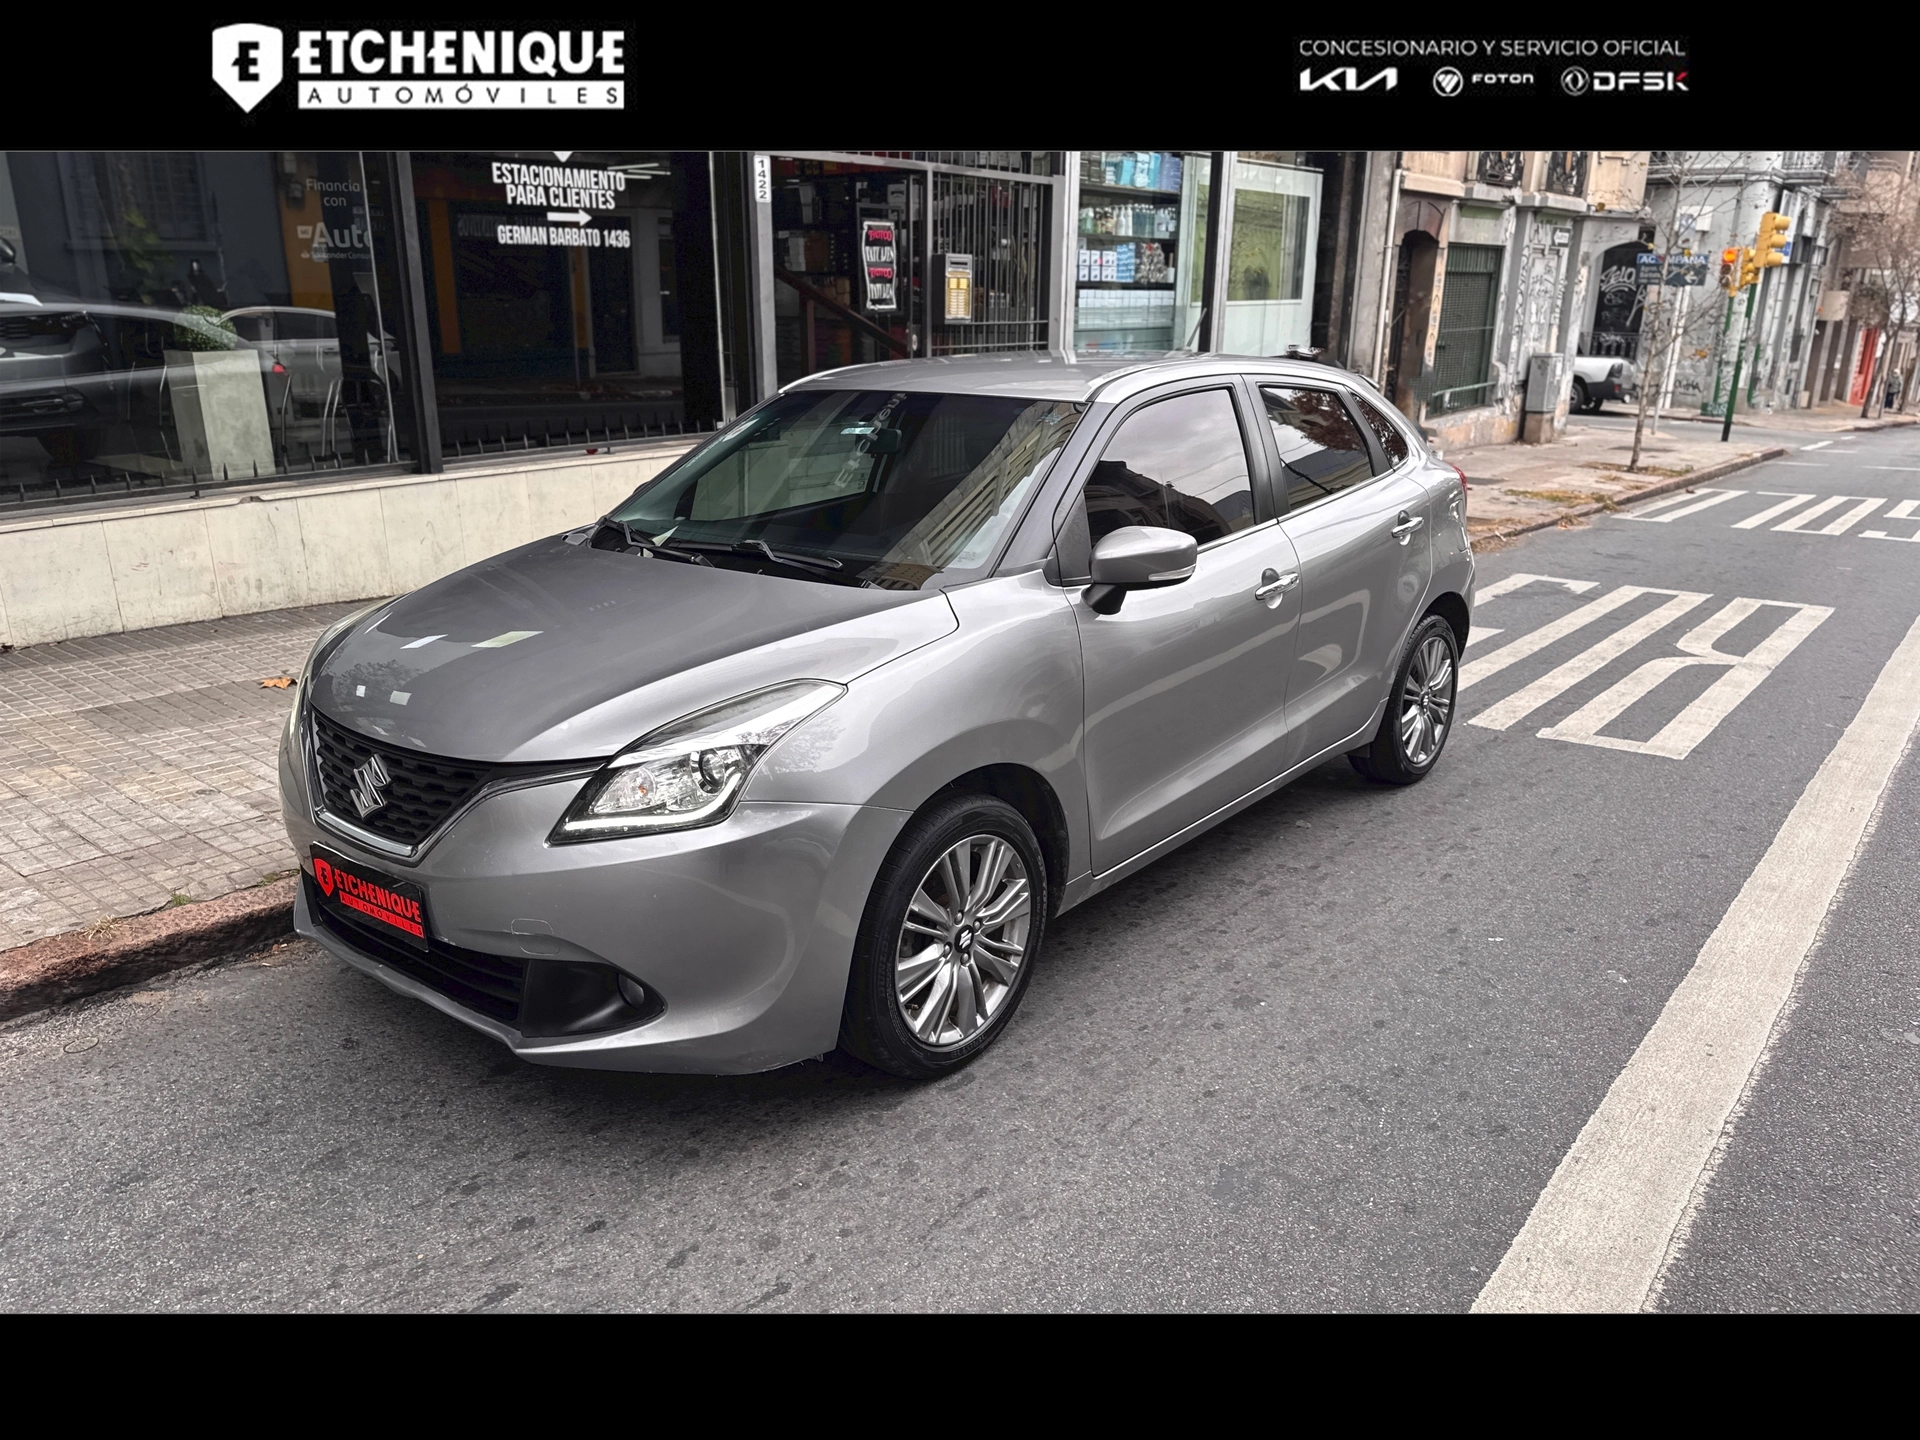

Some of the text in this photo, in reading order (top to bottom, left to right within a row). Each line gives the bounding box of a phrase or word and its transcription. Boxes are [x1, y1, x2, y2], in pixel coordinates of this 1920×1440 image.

[305, 178, 360, 193] Financia
[492, 162, 626, 192] ESTACIONAMIENTO
[757, 159, 768, 200] 1422
[323, 196, 347, 207] con
[506, 183, 616, 210] PARA CLIENTES
[497, 224, 548, 245] GERMAN
[549, 226, 601, 247] BARBATO
[602, 229, 631, 248] 1436
[868, 229, 893, 242] TATTOO
[869, 267, 893, 280] TATTOO
[333, 867, 422, 923] ETCHENIQUE
[340, 892, 424, 936] AUTOMÓVILES
